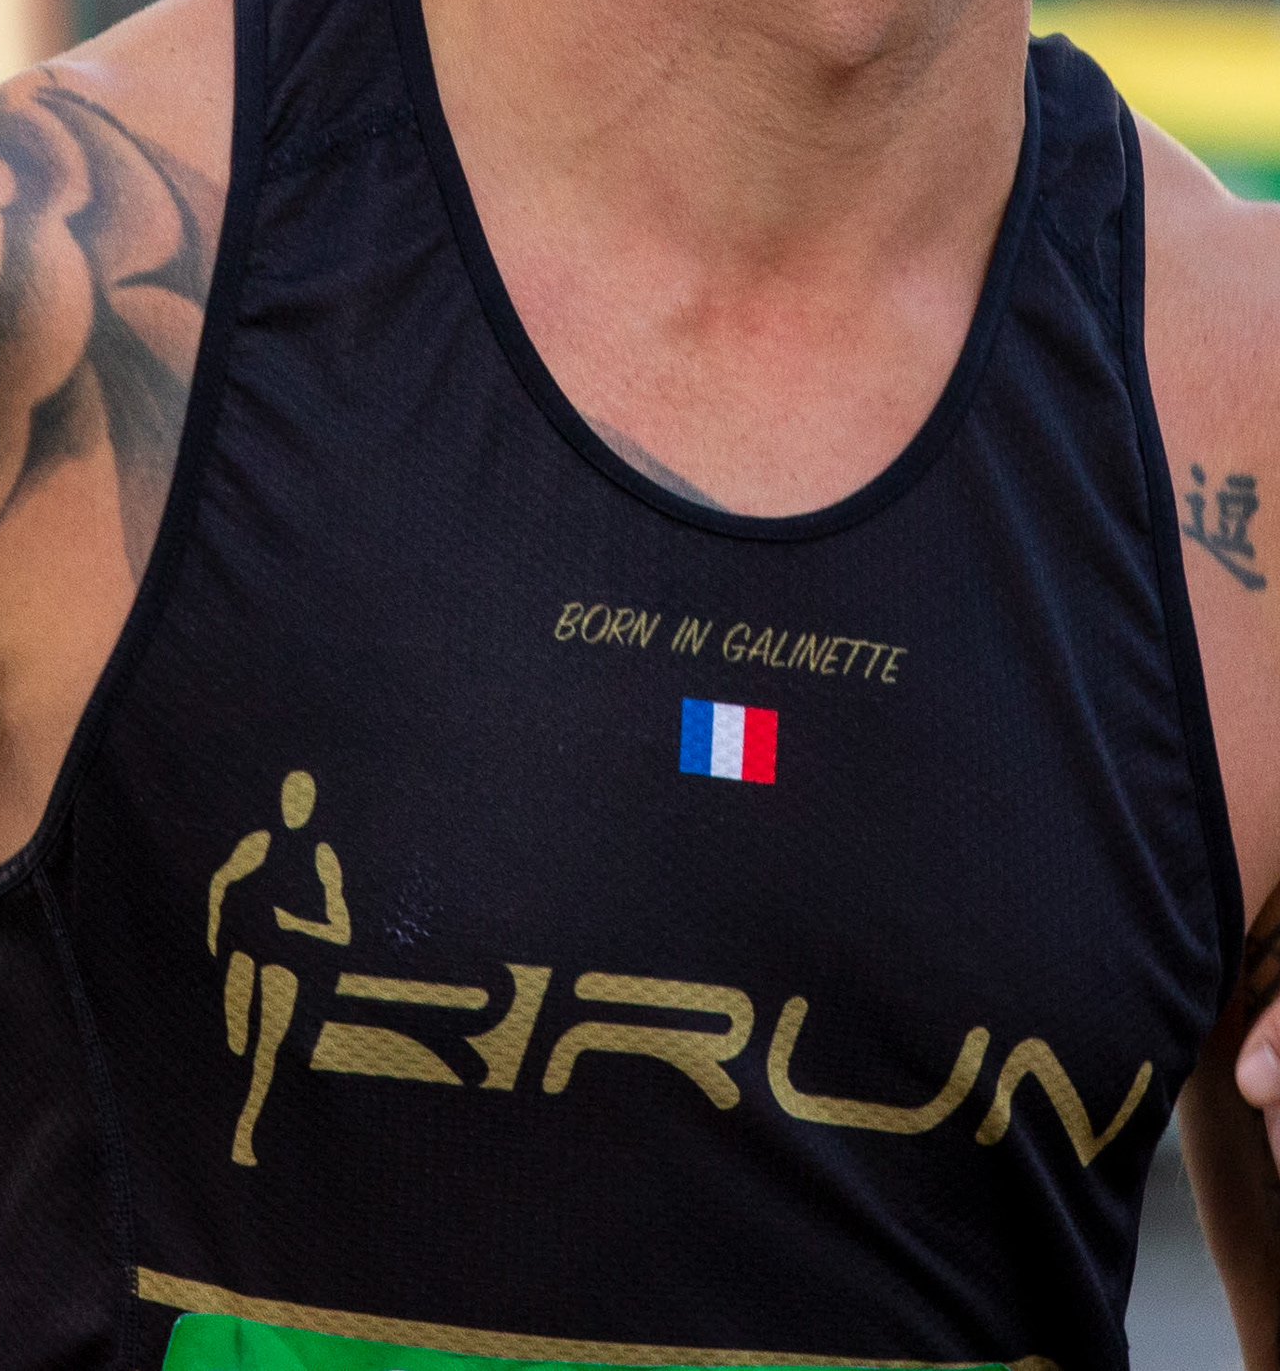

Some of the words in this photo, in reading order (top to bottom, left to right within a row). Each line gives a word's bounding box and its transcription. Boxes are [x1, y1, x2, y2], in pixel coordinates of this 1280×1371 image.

[554, 601, 661, 649] BORN
[671, 615, 713, 657] IN
[722, 622, 909, 685] GALINETTE
